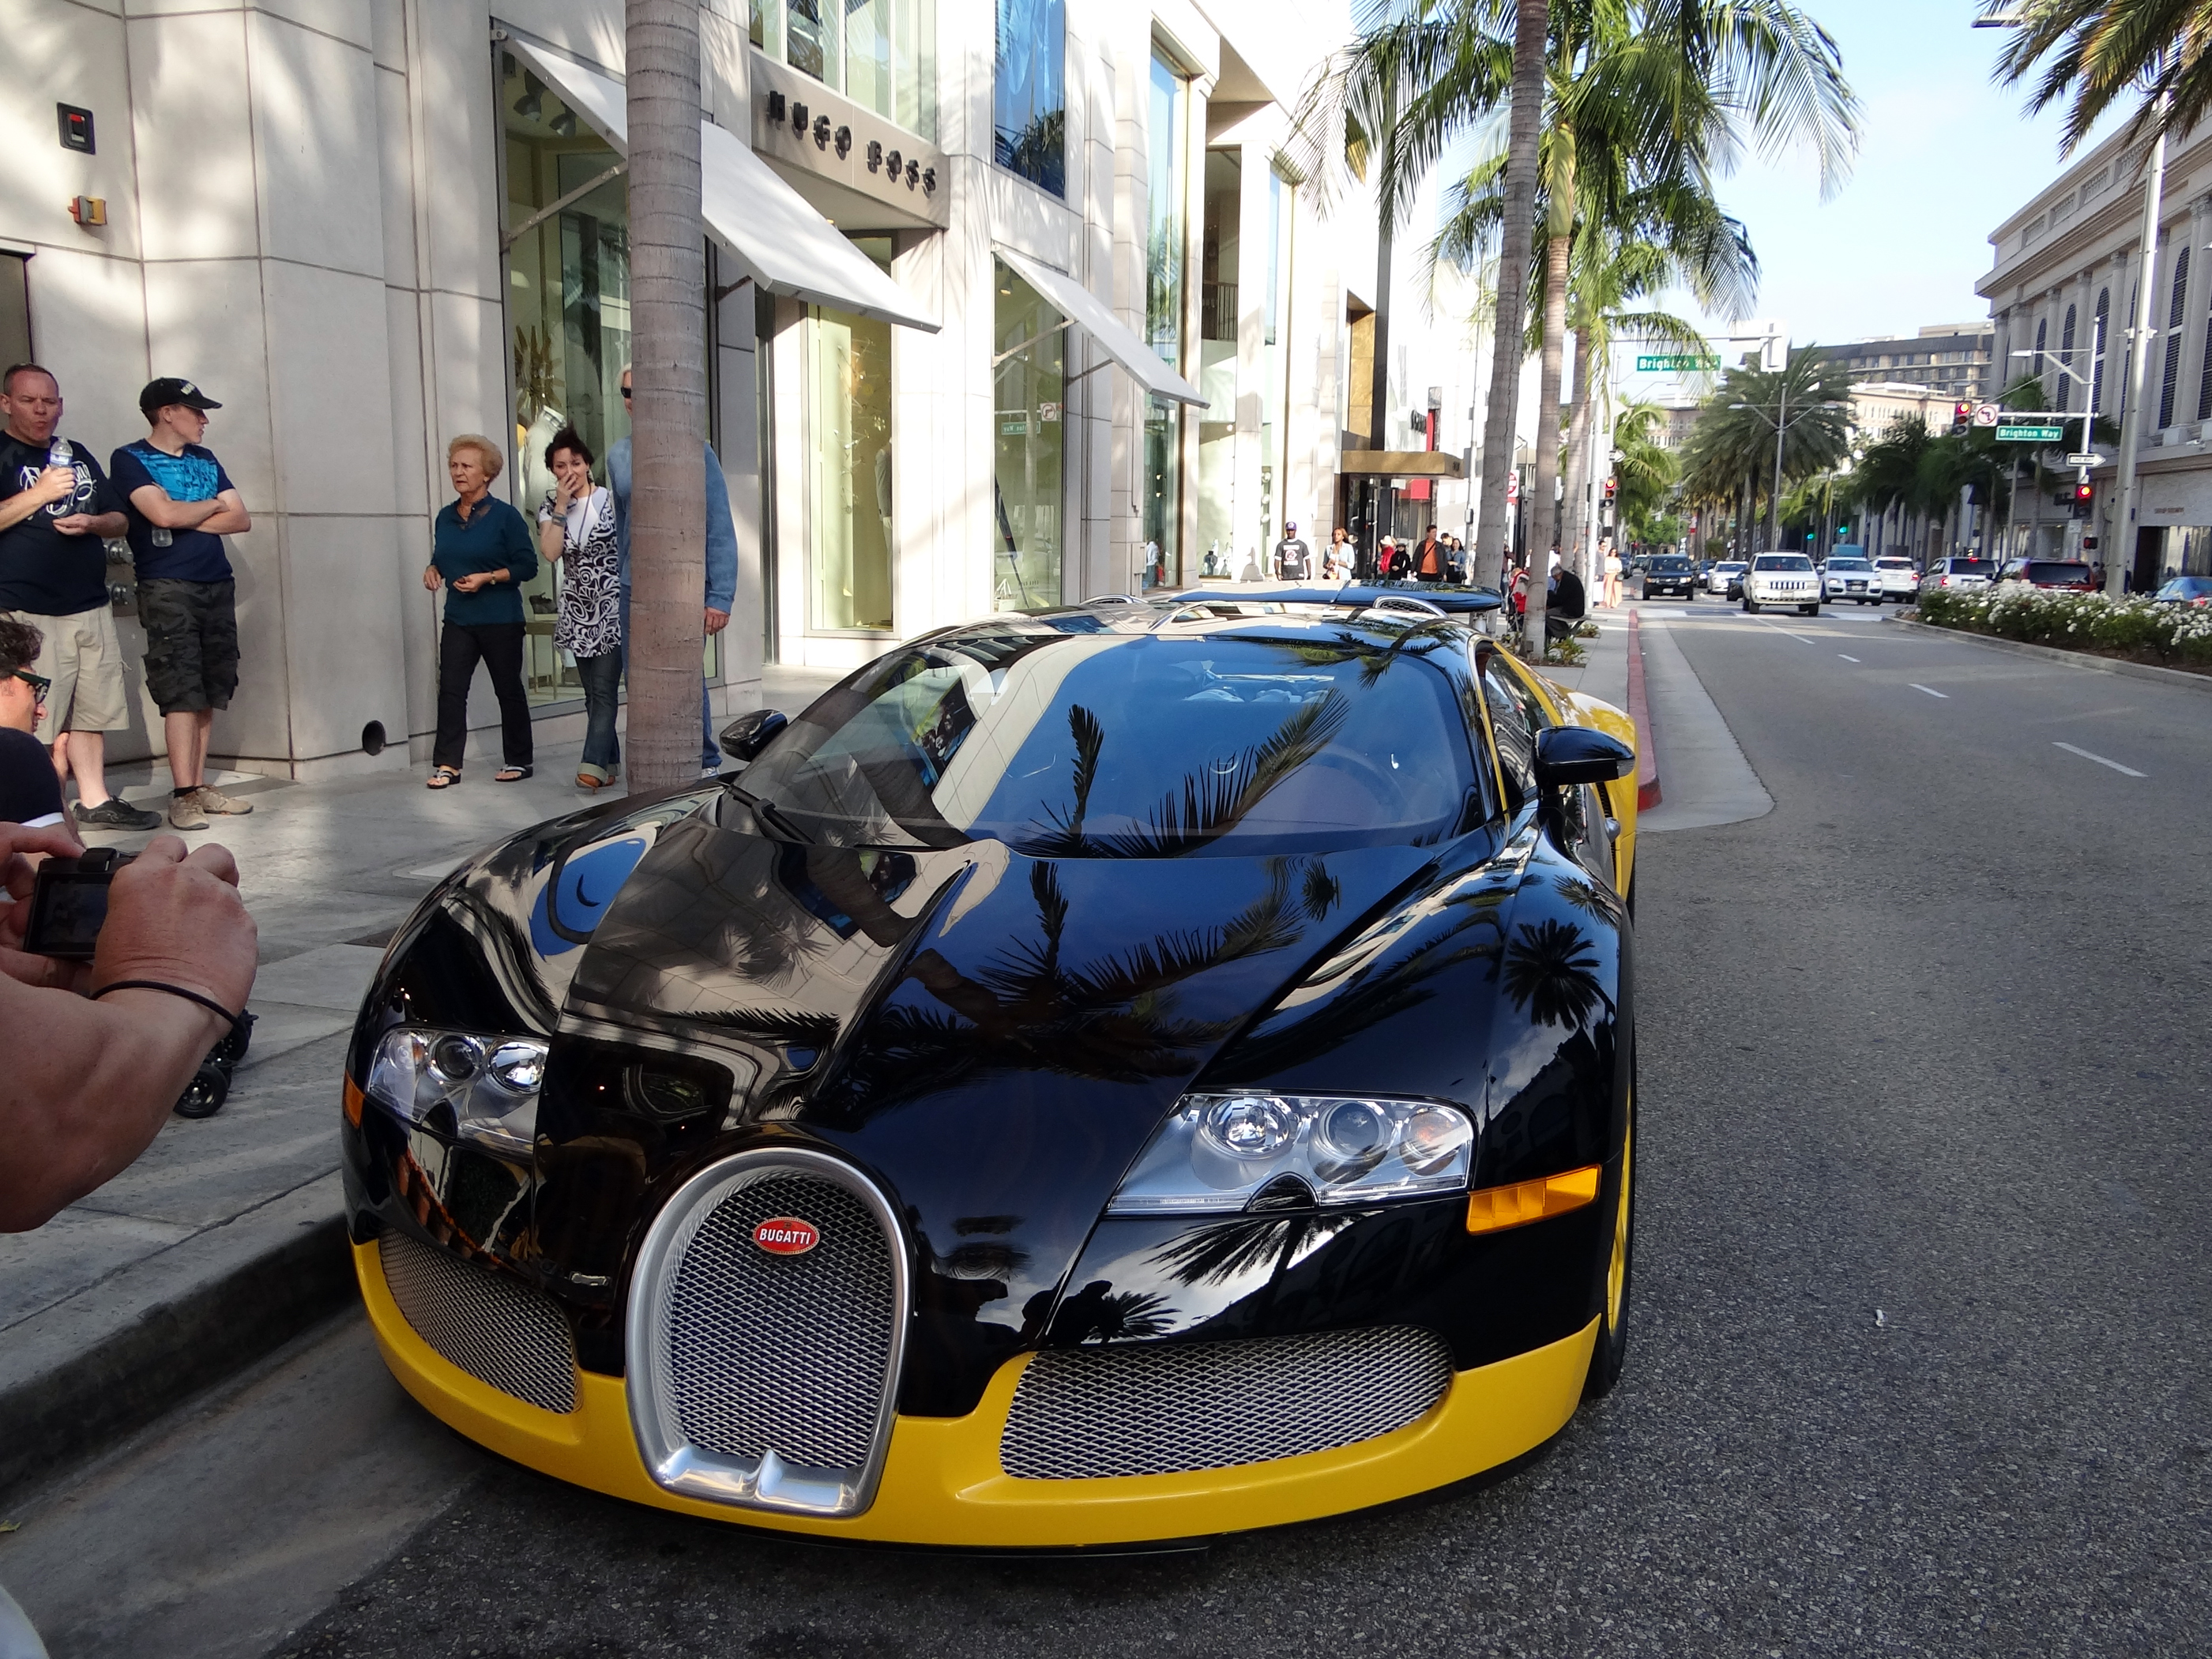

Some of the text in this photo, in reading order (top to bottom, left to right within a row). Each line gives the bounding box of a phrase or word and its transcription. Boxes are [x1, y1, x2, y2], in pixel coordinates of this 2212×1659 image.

[769, 90, 936, 192] HUGO BOSS
[1999, 428, 2059, 439] Brighton Way
[759, 1228, 811, 1245] BUGATTI
